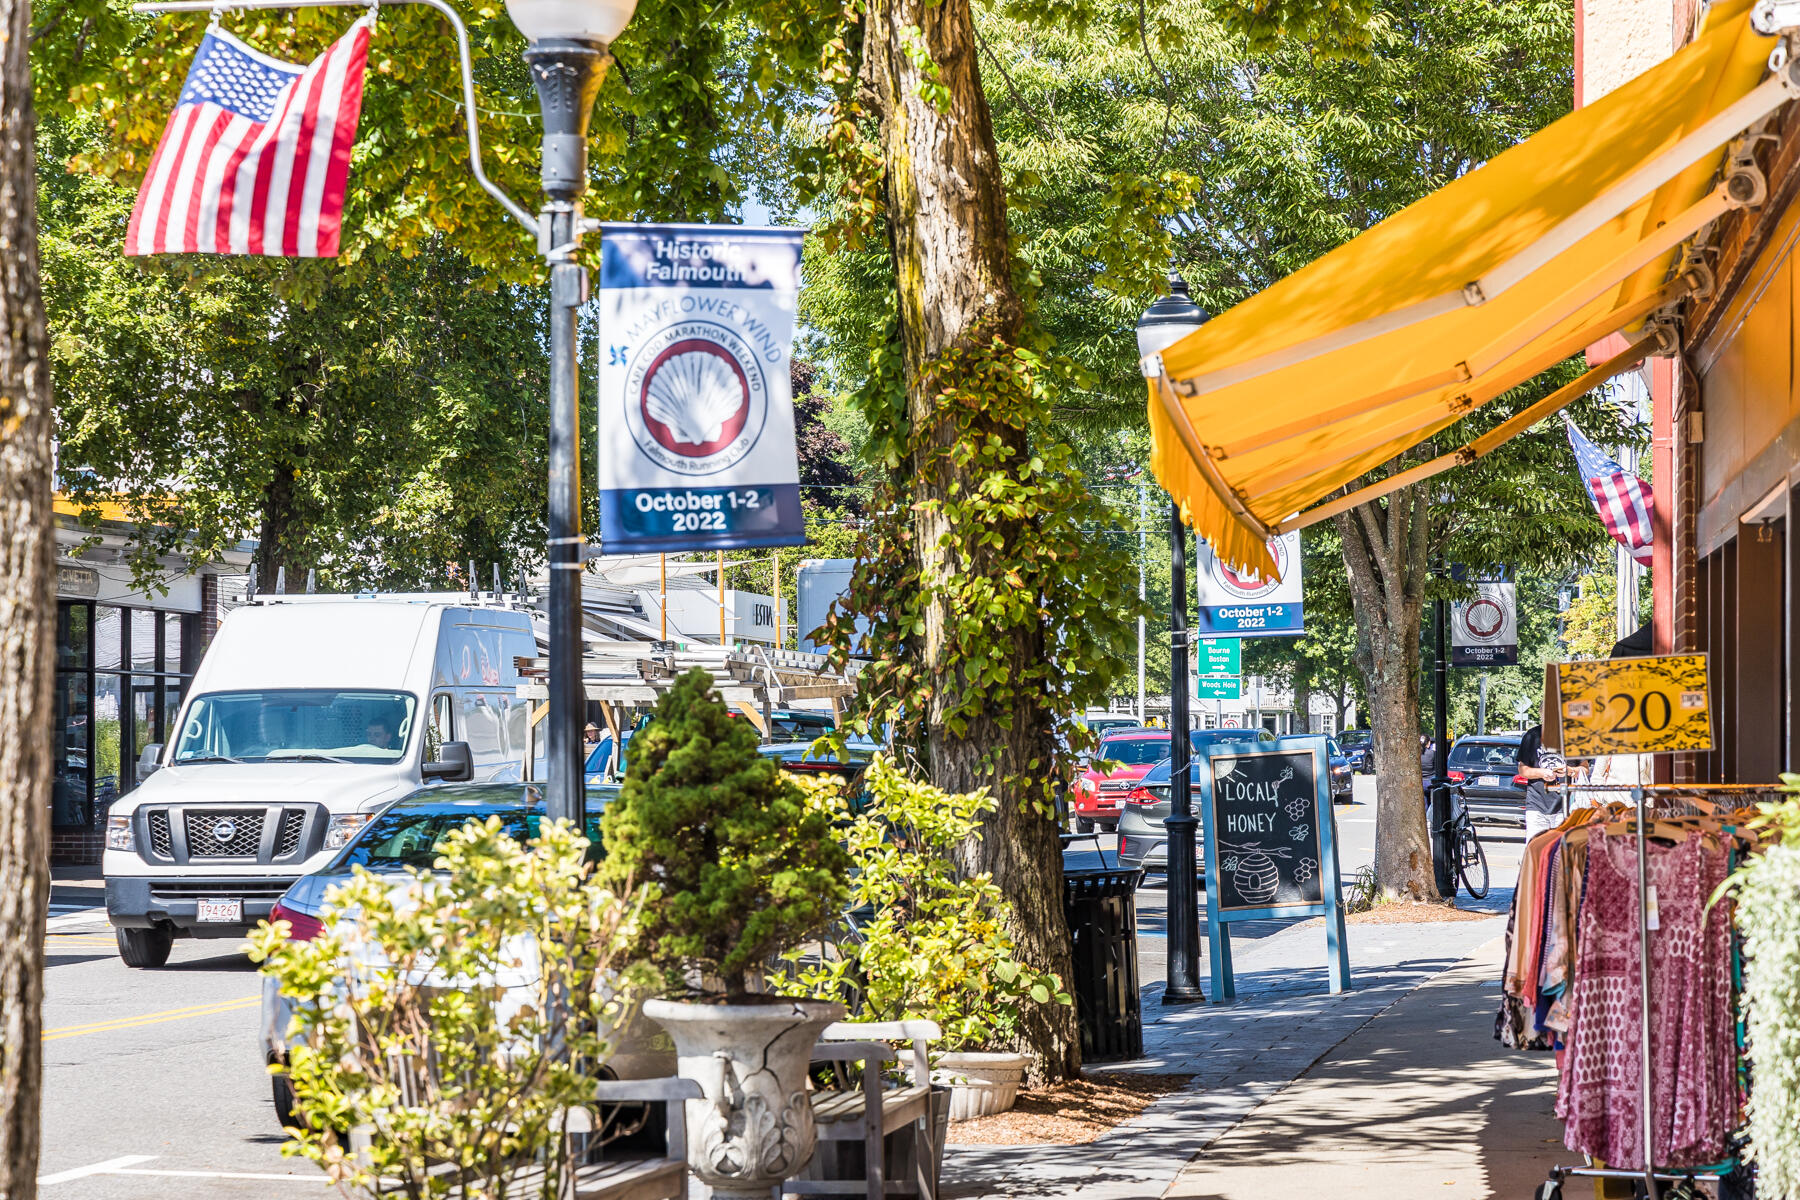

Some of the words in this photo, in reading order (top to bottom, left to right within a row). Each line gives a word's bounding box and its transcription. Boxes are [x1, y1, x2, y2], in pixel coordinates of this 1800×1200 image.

[656, 240, 742, 260] Historic
[646, 262, 746, 282] Falmouth
[626, 295, 739, 342] MAYFLOWER
[742, 311, 782, 363] WIND
[630, 366, 647, 395] CAPE
[664, 326, 729, 343] MARATHON
[728, 341, 761, 392] WEEKEND
[635, 491, 724, 513] October
[727, 490, 760, 509] 1-2
[672, 512, 727, 531] 2022
[1218, 606, 1265, 619] October
[1267, 606, 1284, 617] 1-2
[1237, 617, 1266, 628] 2022
[1207, 646, 1231, 654] Bourne
[1208, 655, 1230, 663] Boston
[1201, 680, 1222, 689] Woods
[1222, 681, 1237, 689] Hole
[1595, 691, 1672, 733] $20
[1227, 813, 1277, 833] HONEY
